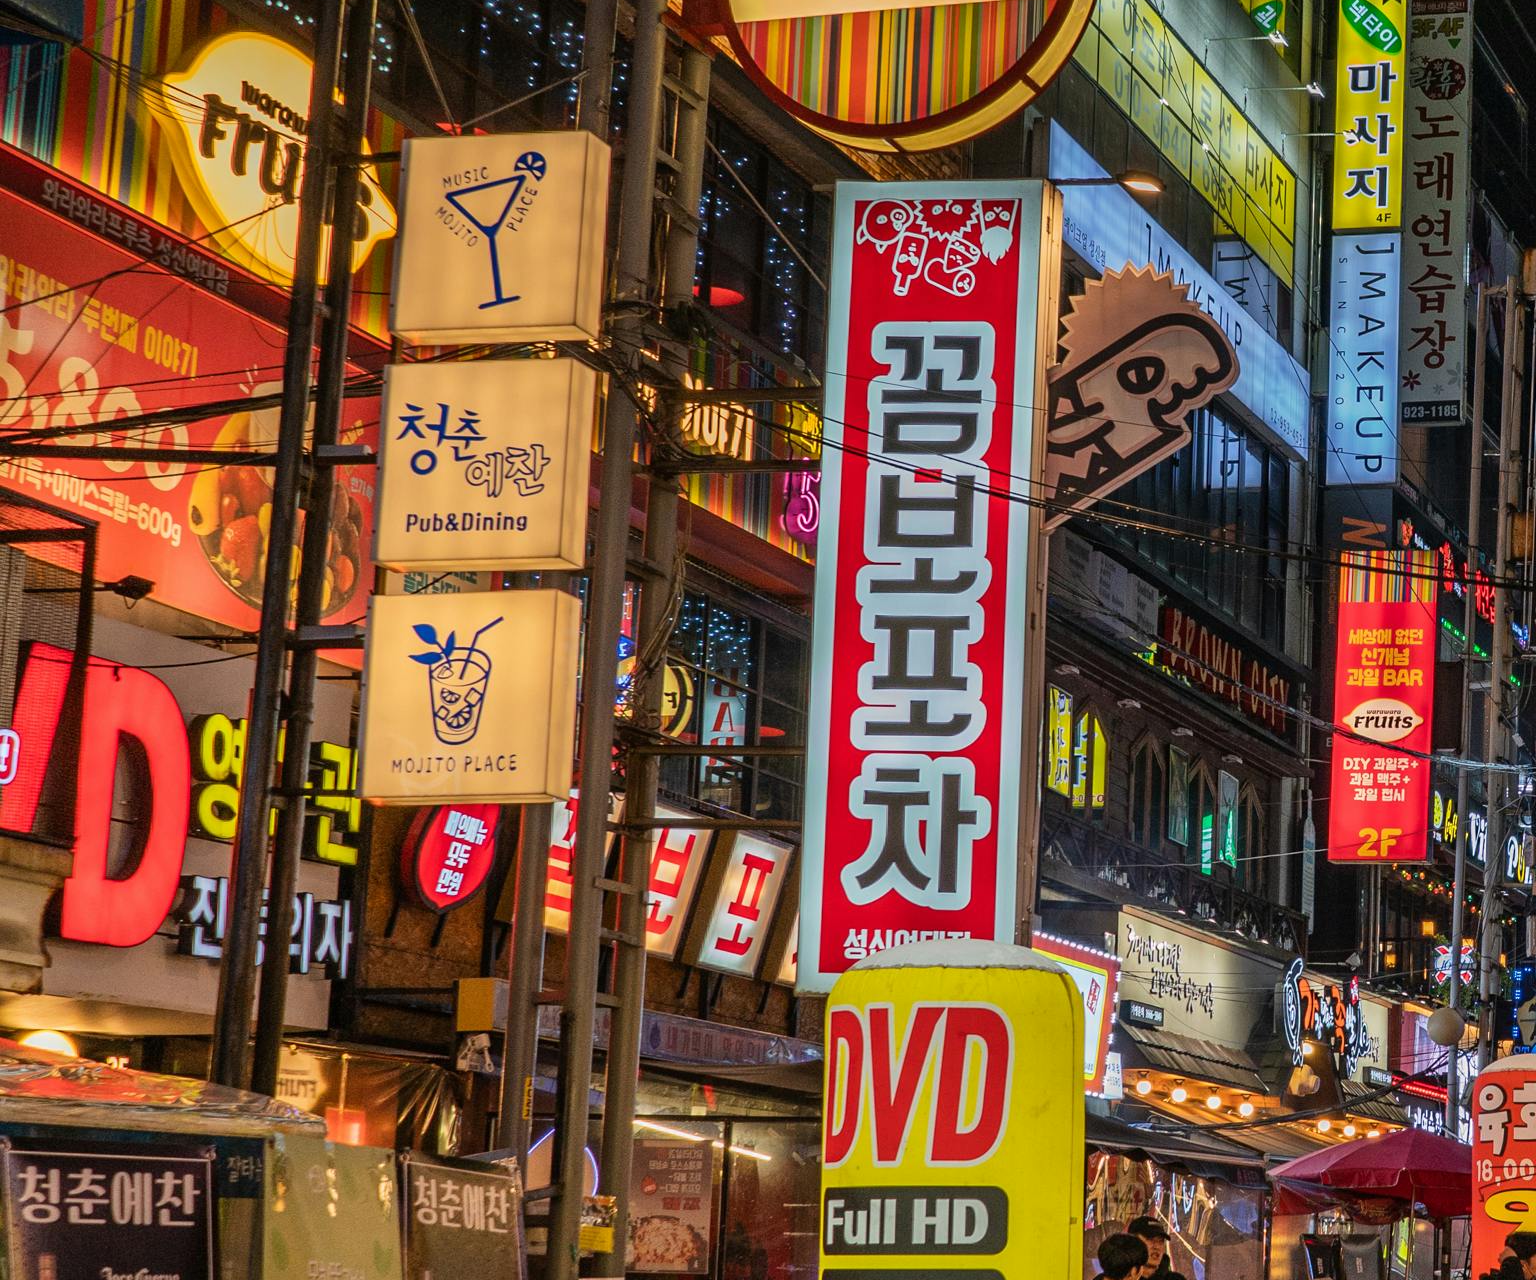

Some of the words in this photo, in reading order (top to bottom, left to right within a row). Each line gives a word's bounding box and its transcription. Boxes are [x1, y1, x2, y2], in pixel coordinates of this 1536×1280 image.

[1343, 61, 1398, 209] 마사지
[441, 166, 490, 191] MUSIC
[434, 206, 480, 249] MOJITO
[507, 184, 540, 234] PLACE
[1375, 212, 1393, 224] 4F
[1408, 105, 1460, 370] 노래연습장
[156, 236, 230, 297] 성신여대점
[144, 325, 199, 382] 이야기
[1402, 403, 1459, 420] 923-1185
[405, 512, 528, 534] Pub&Dining
[858, 334, 984, 896] 꼼보포차
[1348, 628, 1392, 646] 세상에
[1171, 606, 1243, 712] BROWN
[1250, 660, 1291, 734] CITY
[1361, 647, 1410, 667] 신개념
[1346, 668, 1380, 687] 과일
[1383, 668, 1424, 687] BAR
[391, 757, 457, 776] MOJITO
[463, 753, 518, 774] PLACE
[1343, 757, 1371, 771] DIY
[1349, 772, 1374, 787] 과일
[1353, 787, 1380, 802] 과일
[1381, 787, 1406, 803] 접시
[1356, 827, 1403, 858] 2F
[825, 1001, 1015, 1170] DVD
[17, 1165, 201, 1227] 청춘예찬
[413, 1180, 510, 1234] 청춘예찬
[826, 1198, 894, 1247] Full
[911, 1198, 989, 1245] HD
